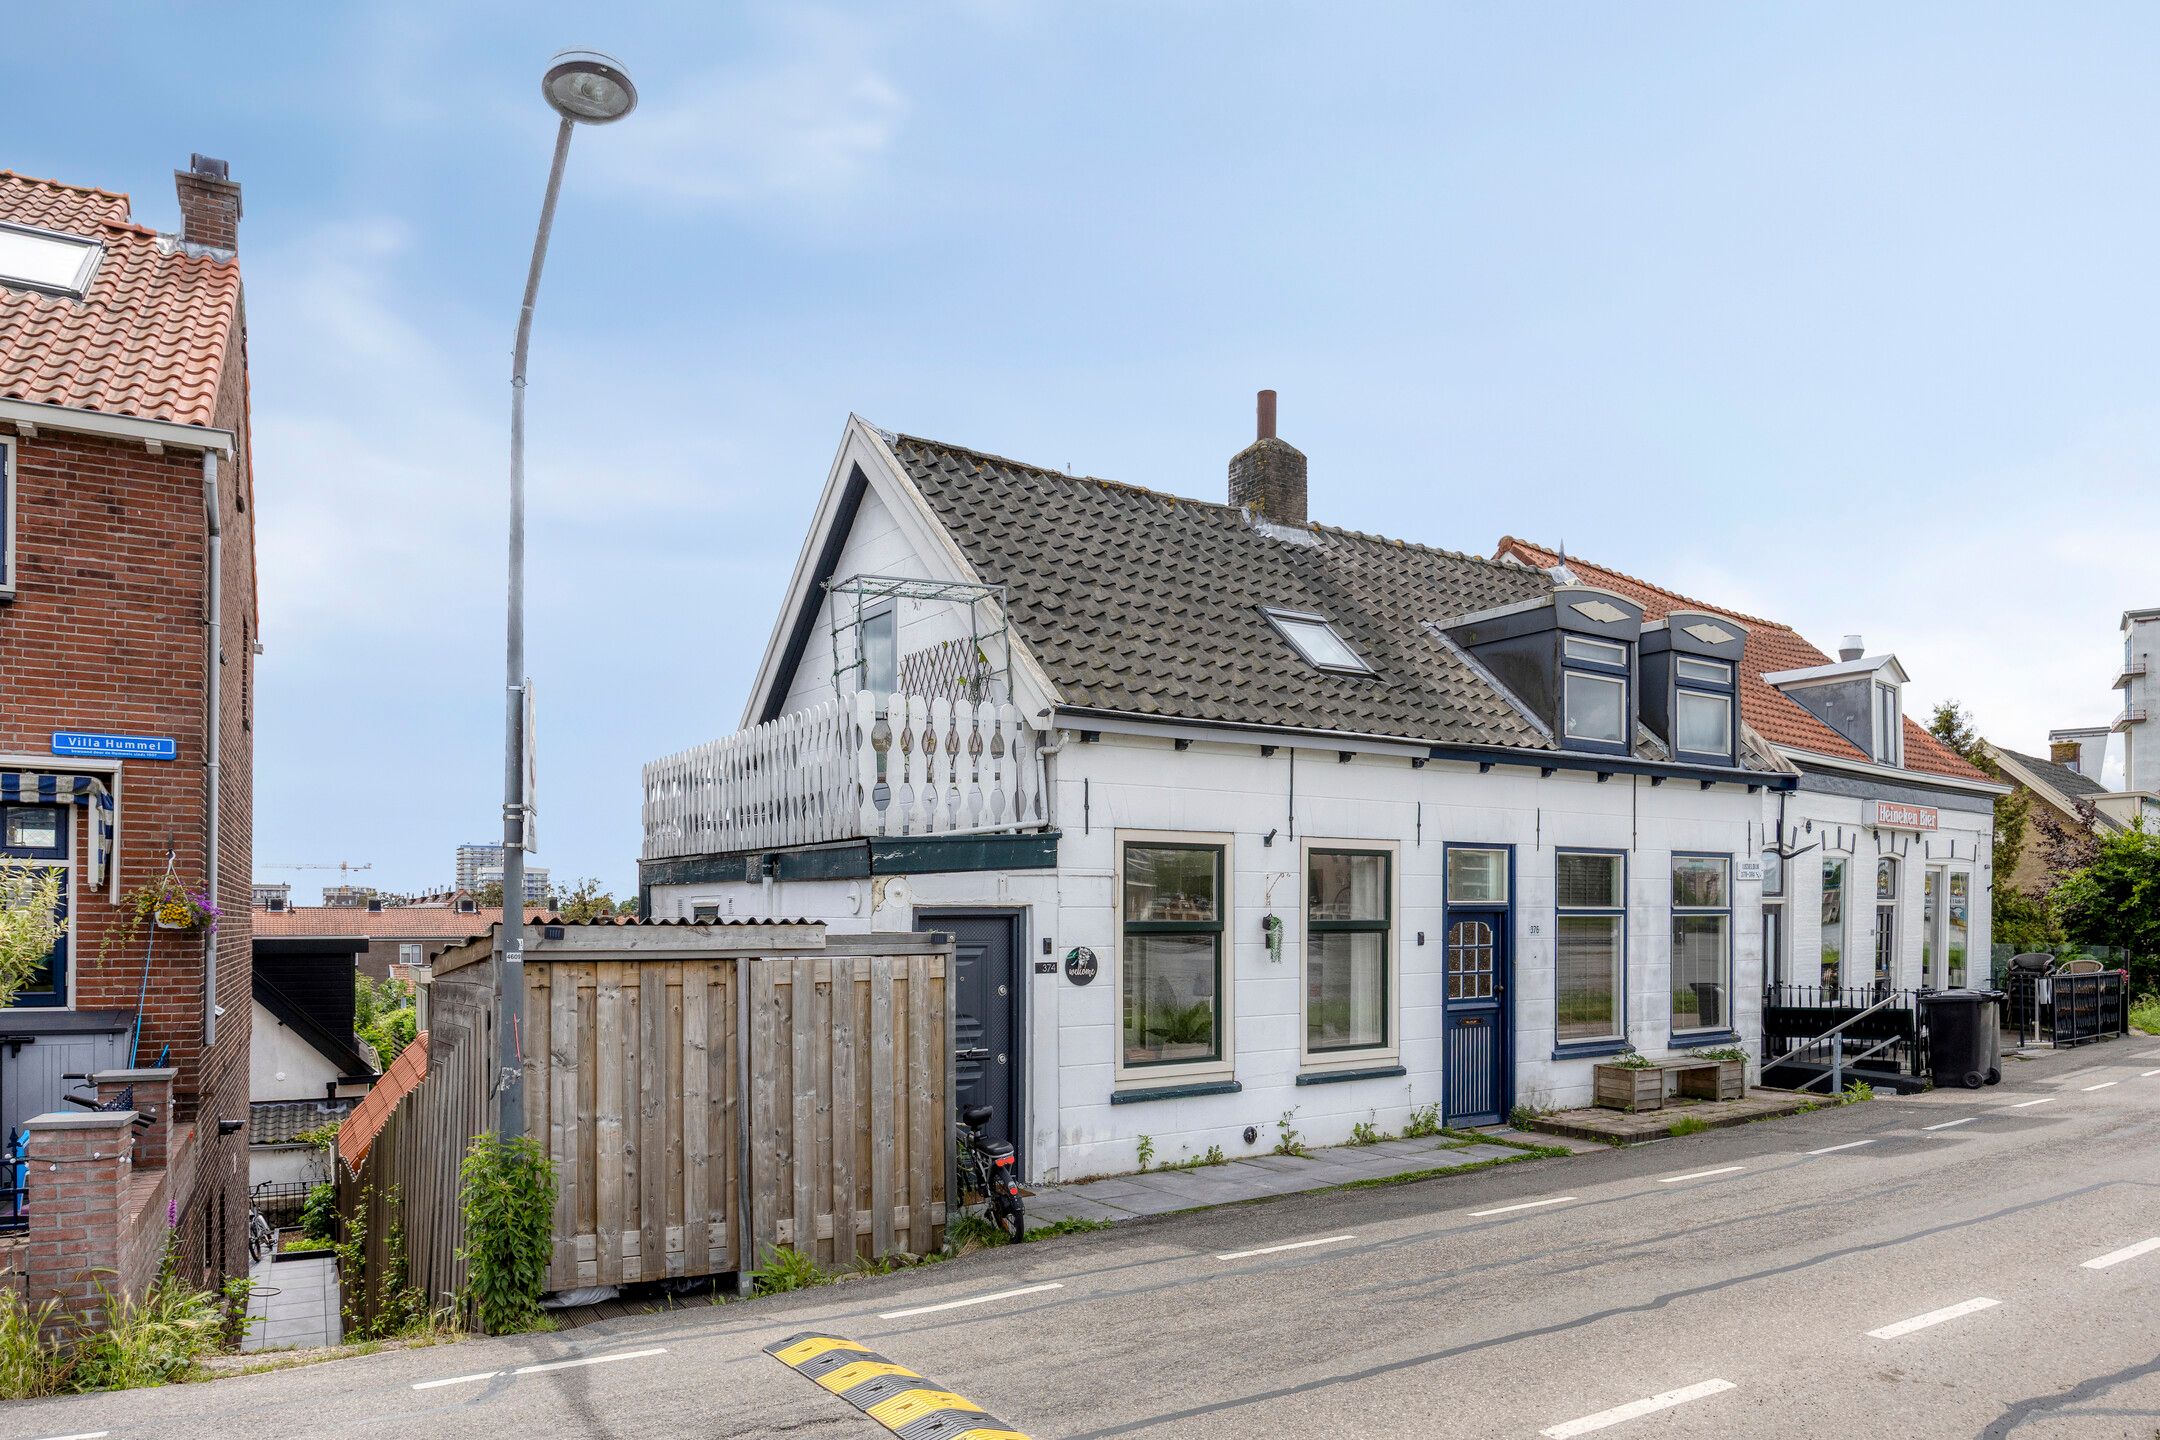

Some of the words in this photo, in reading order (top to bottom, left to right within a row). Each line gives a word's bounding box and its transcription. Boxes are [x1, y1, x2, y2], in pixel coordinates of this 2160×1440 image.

[68, 737, 100, 748] Villa
[106, 739, 161, 751] Hummel
[1879, 804, 1918, 826] Heineken
[1919, 809, 1937, 827] Bier
[1042, 963, 1056, 972] 374
[1068, 968, 1096, 977] welcome
